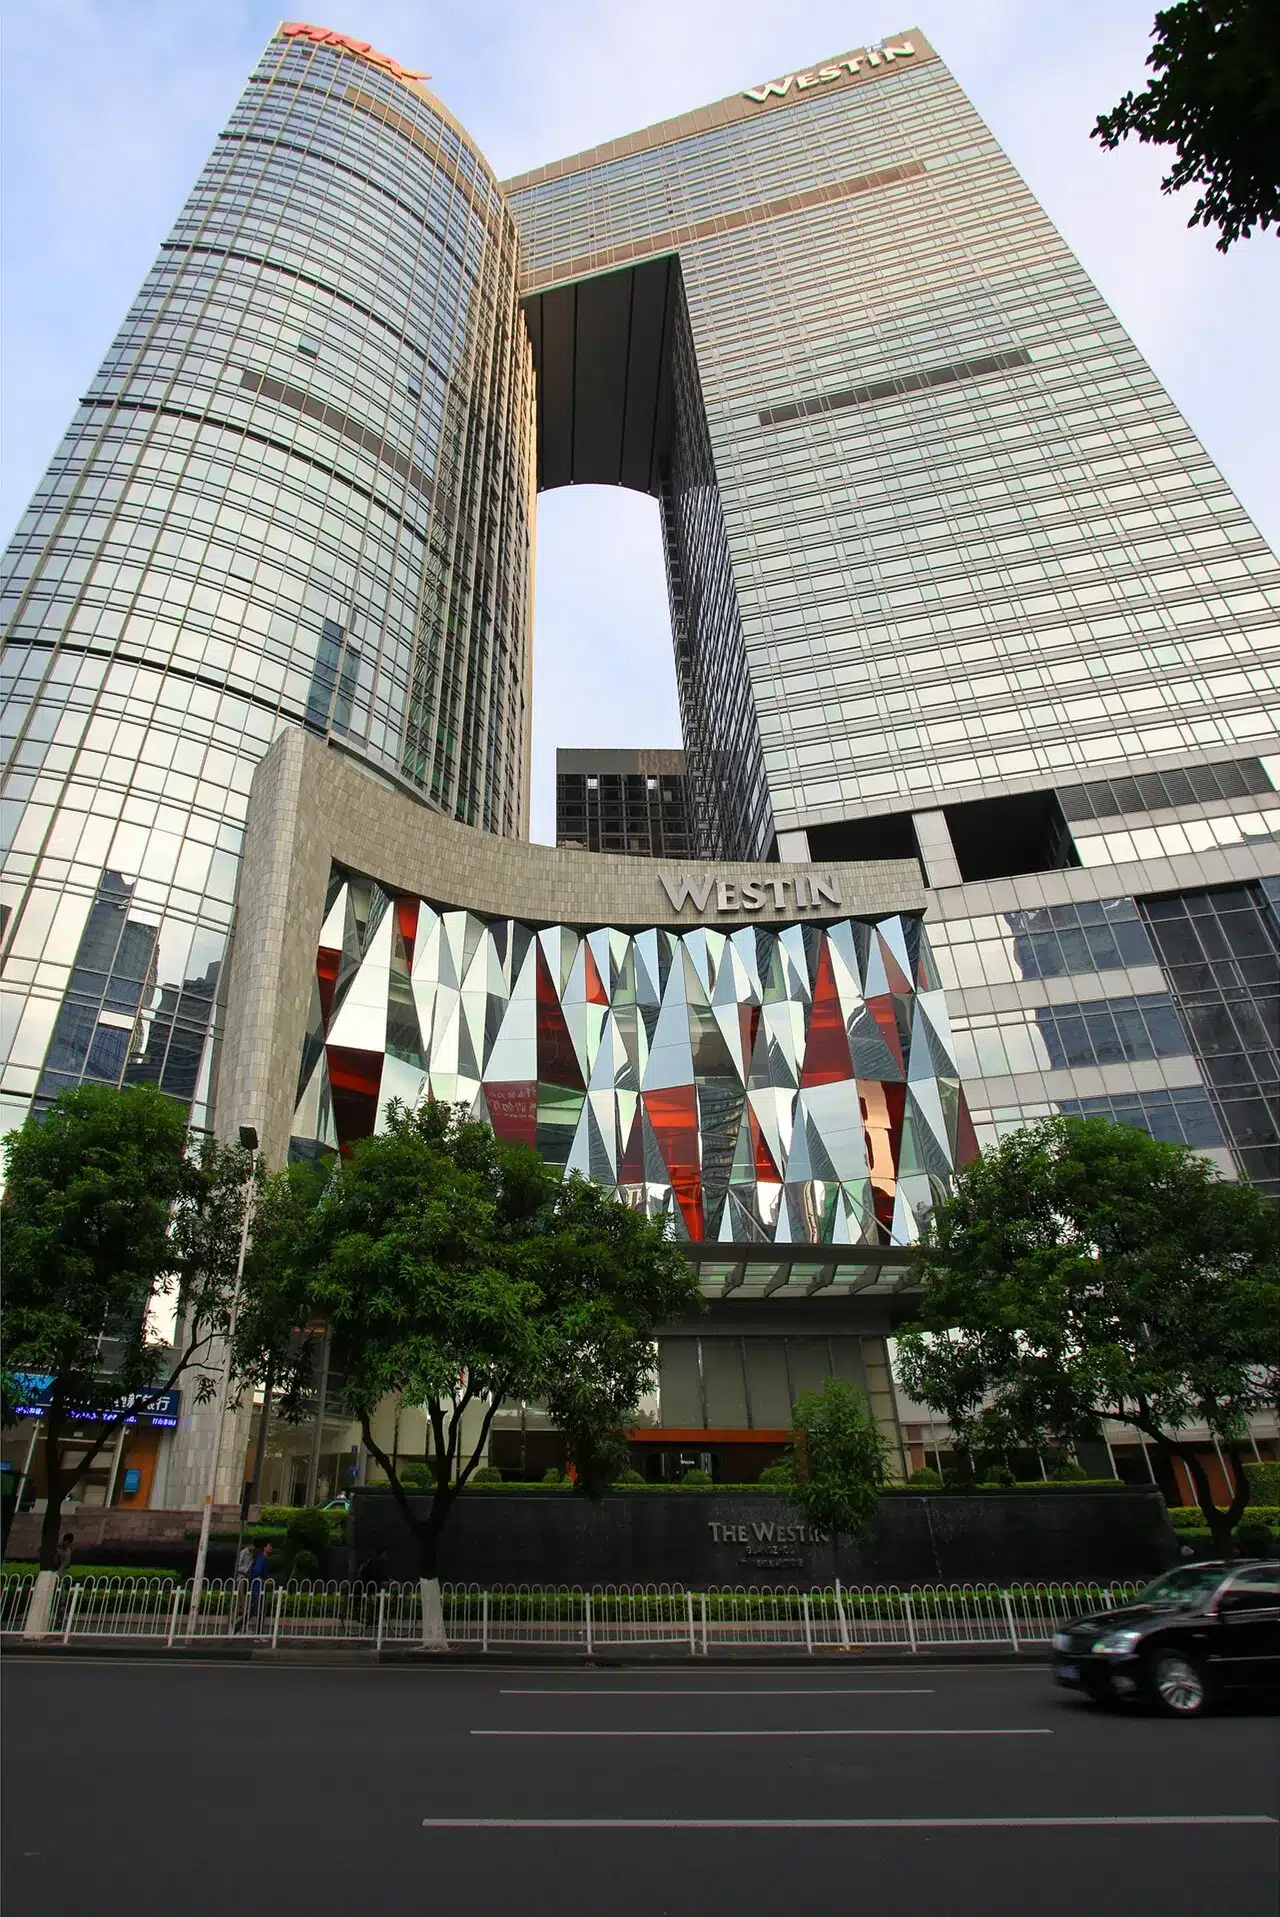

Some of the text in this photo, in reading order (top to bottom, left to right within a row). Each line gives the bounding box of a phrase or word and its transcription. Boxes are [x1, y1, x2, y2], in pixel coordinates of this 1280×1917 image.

[743, 41, 916, 102] WESTIN
[658, 872, 842, 912] WESTIN
[708, 1522, 748, 1543] THE
